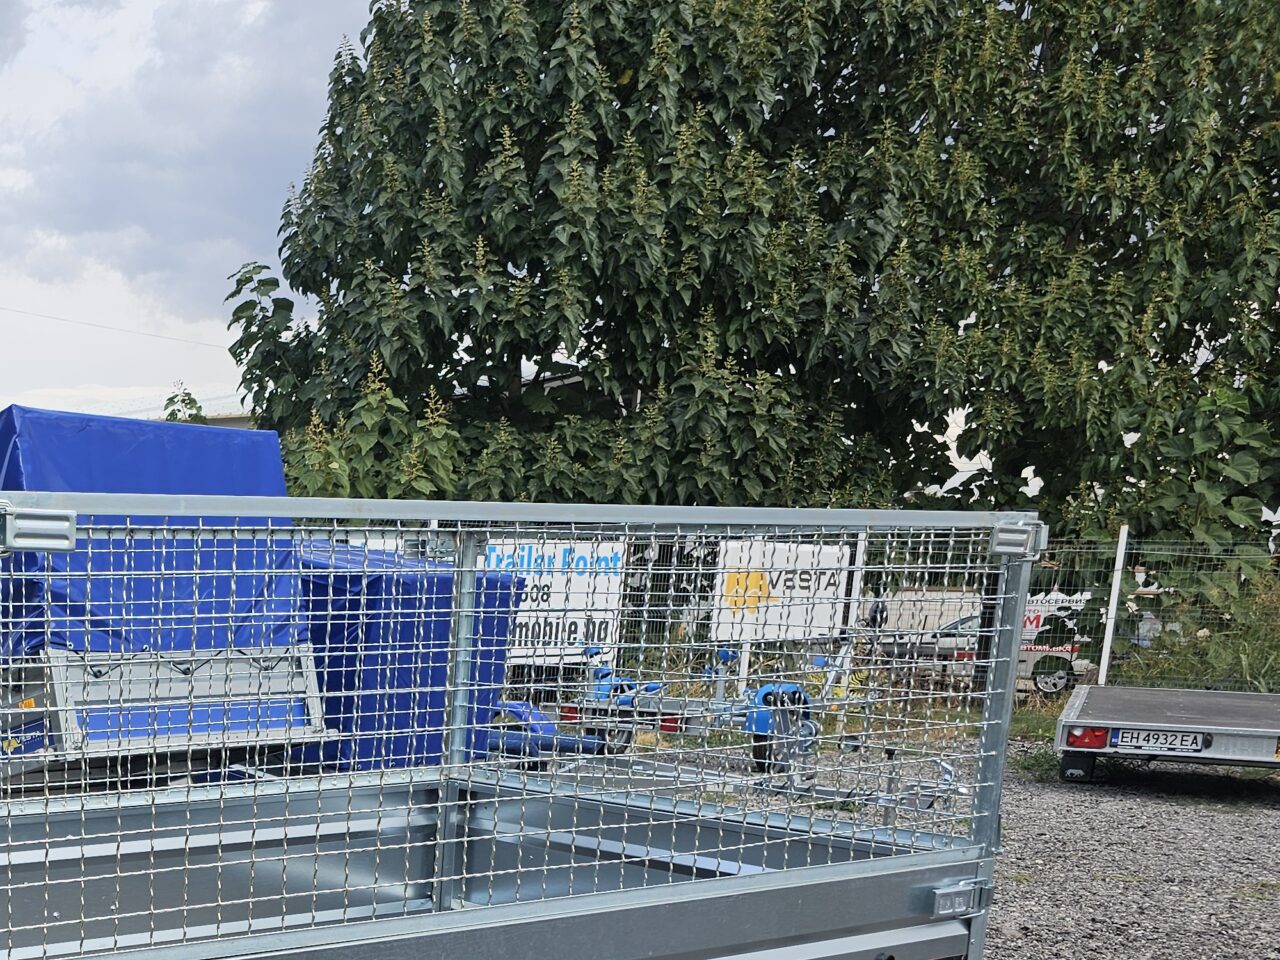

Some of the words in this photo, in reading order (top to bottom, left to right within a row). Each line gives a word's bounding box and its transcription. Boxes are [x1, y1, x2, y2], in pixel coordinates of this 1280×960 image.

[486, 544, 557, 576] Trailer
[561, 547, 621, 576] Point
[769, 570, 838, 591] VESTA
[1120, 731, 1140, 744] EH
[1142, 732, 1178, 746] 4932
[1180, 734, 1199, 747] EA
